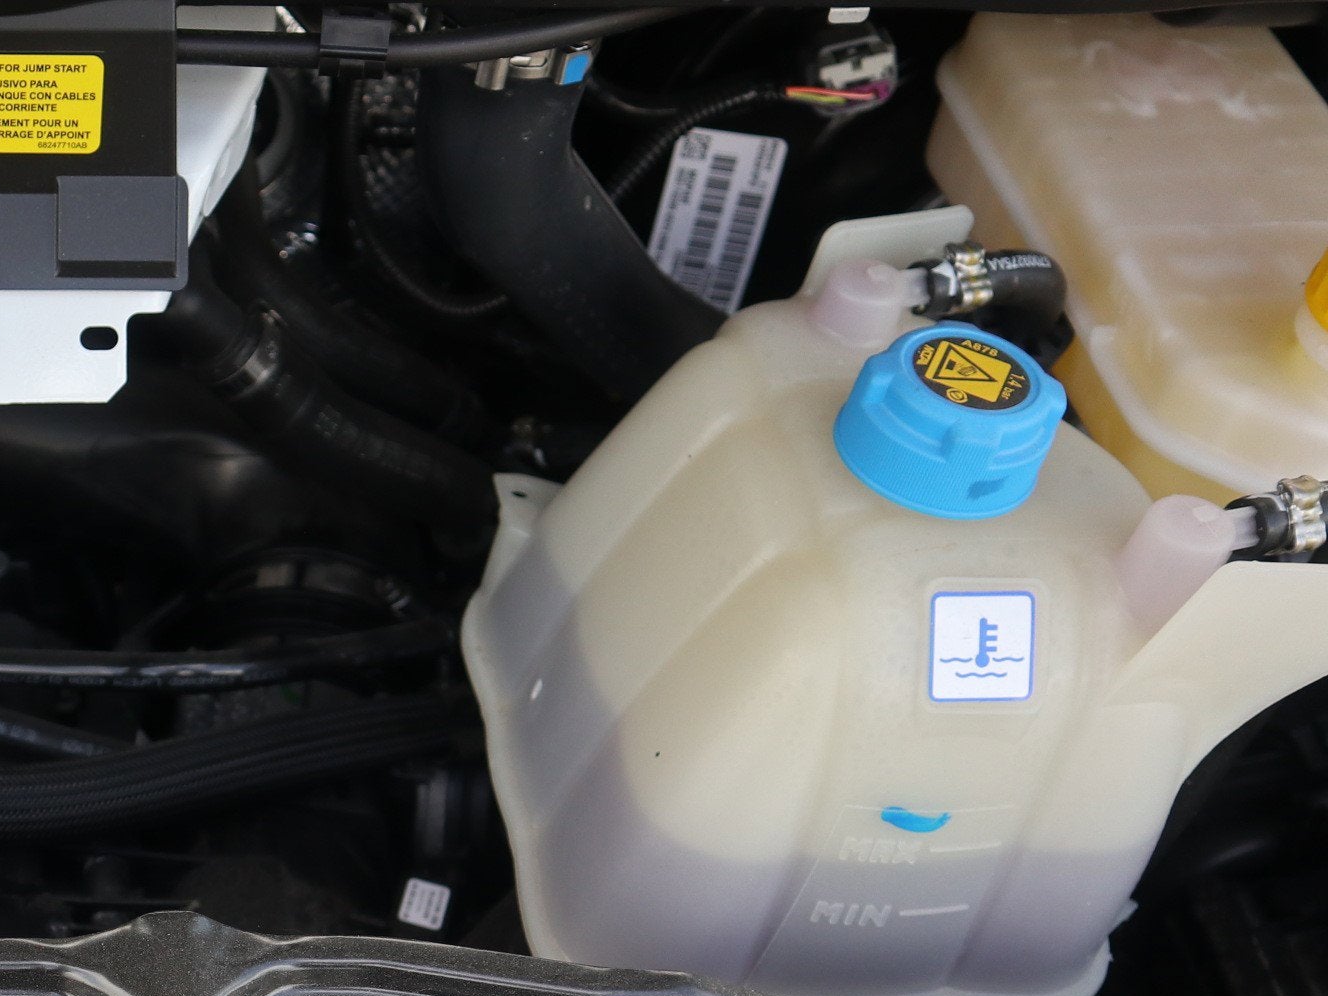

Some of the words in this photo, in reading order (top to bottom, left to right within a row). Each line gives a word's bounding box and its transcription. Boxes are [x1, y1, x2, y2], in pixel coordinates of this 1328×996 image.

[22, 64, 51, 73] JUMP
[53, 64, 87, 73] START
[29, 80, 58, 88] PARA
[29, 92, 52, 100] CON
[54, 92, 96, 101] CABLES
[32, 119, 61, 128] POUR
[64, 119, 79, 128] UN
[36, 130, 91, 139] D'APPOINT
[37, 141, 88, 149] 68247710AB
[810, 900, 892, 927] MIN
